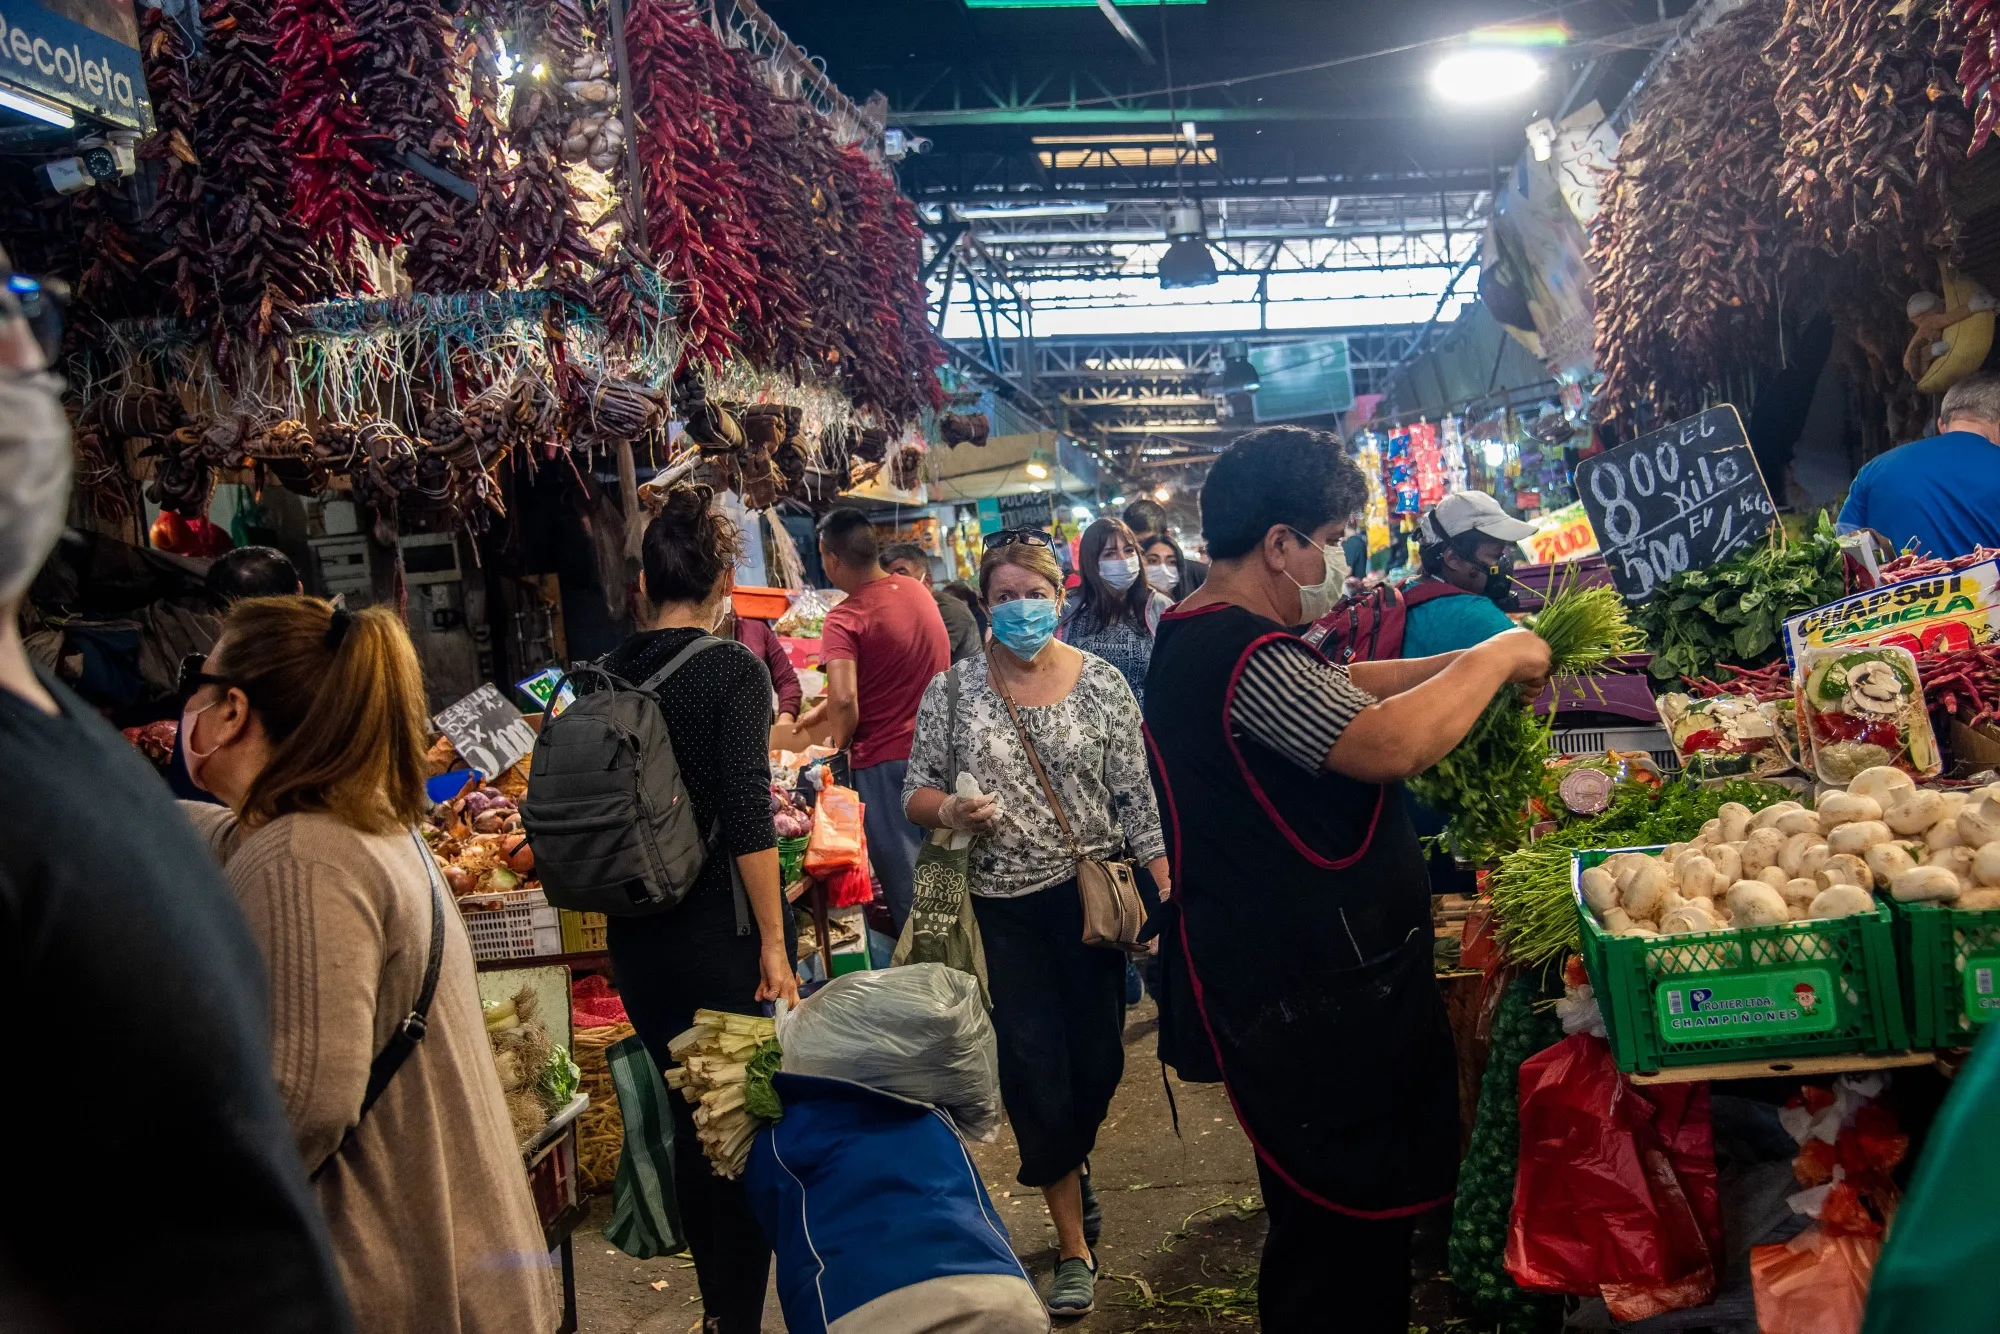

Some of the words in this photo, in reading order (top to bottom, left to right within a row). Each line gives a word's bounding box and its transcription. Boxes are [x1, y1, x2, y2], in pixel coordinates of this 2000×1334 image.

[0, 12, 135, 109] Recoleta
[1590, 441, 1680, 546] 800
[1533, 523, 1591, 566] 200
[1617, 532, 1690, 601] 500
[1821, 594, 1975, 644] CAZUELA
[1671, 1009, 1799, 1029] CHAMPIÑONES
